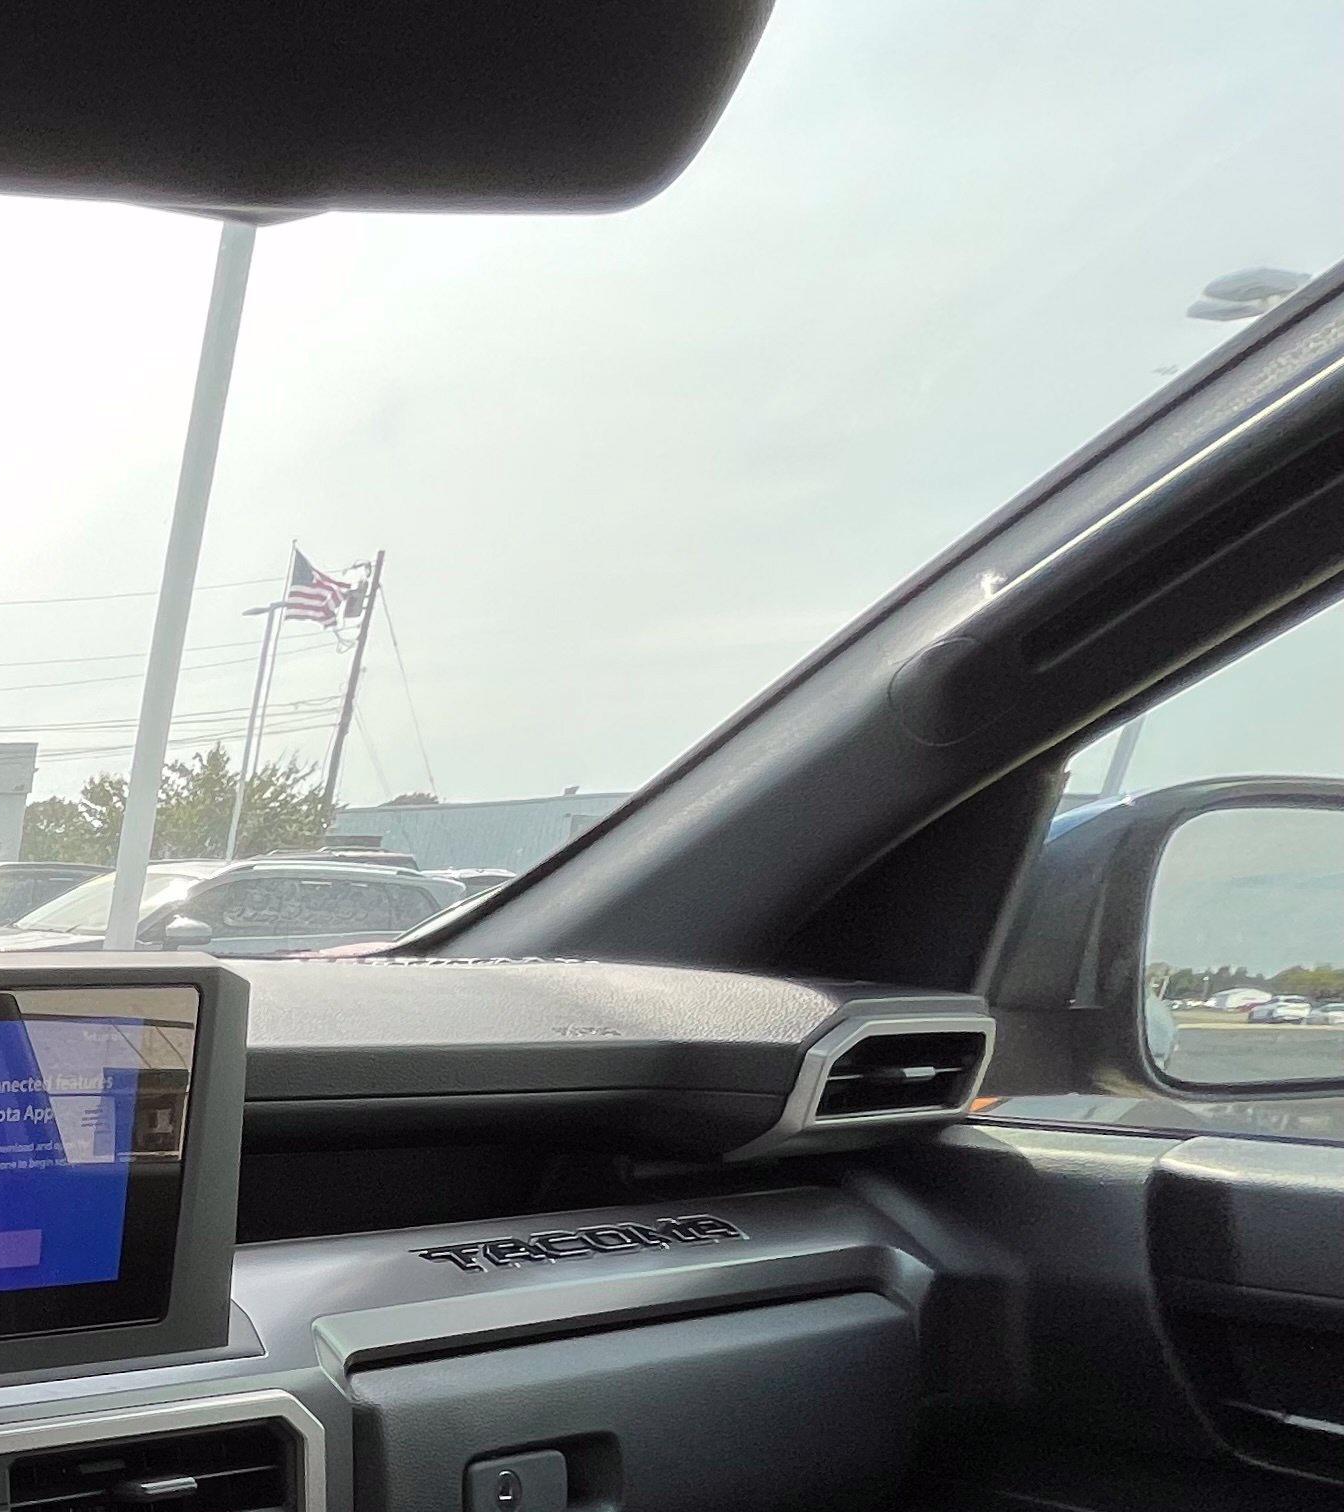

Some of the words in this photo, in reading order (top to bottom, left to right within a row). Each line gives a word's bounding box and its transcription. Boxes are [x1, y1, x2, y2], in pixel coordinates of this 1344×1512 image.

[24, 1104, 55, 1125] App
[18, 1160, 27, 1169] to
[29, 1157, 53, 1170] begin
[410, 1213, 750, 1273] TACOMA
